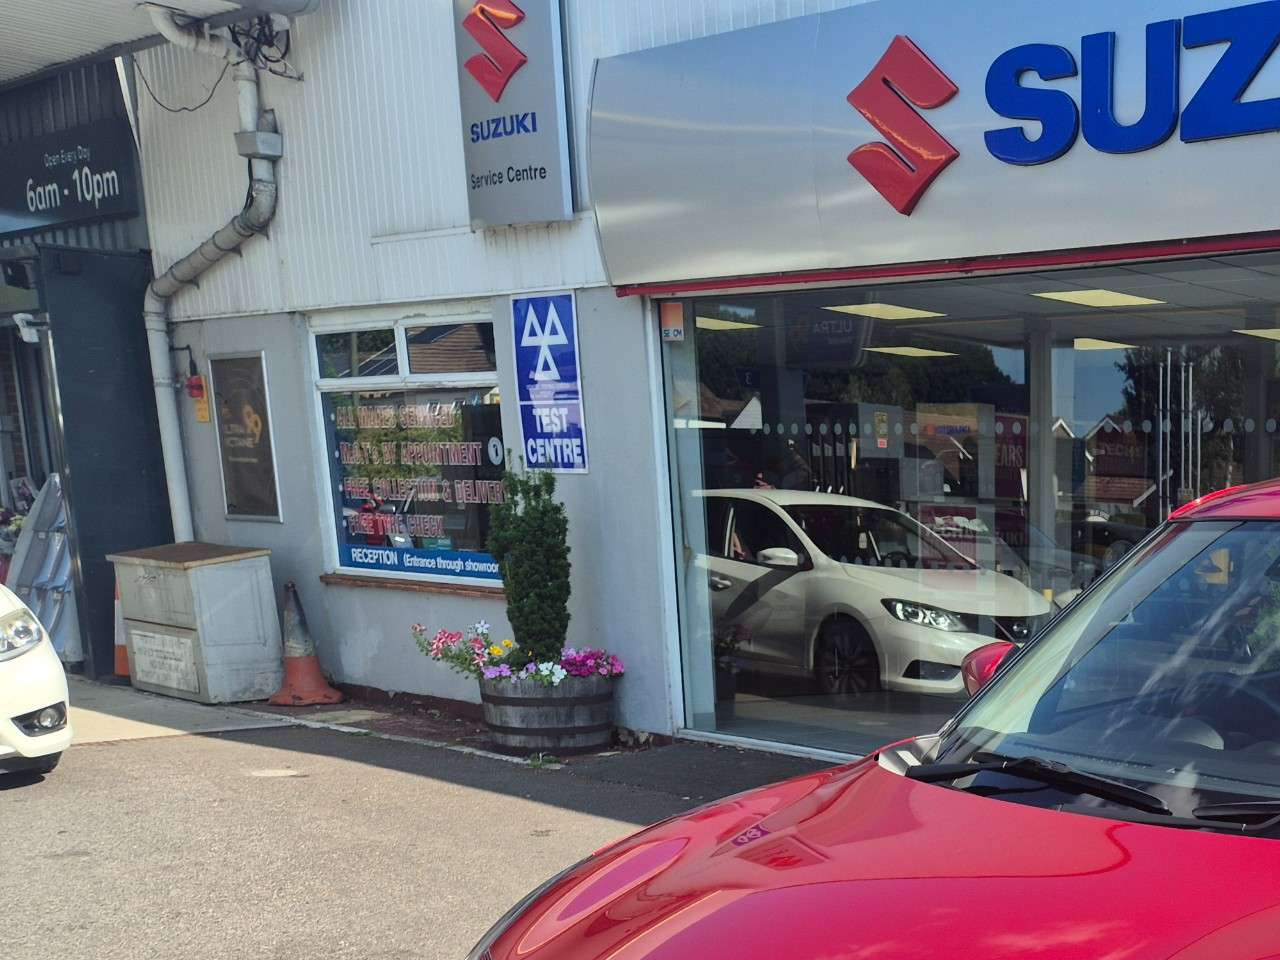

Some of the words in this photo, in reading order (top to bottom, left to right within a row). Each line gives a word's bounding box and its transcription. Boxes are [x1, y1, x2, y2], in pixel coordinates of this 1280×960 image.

[470, 112, 538, 143] SUZUKI
[26, 178, 60, 212] 6am
[72, 166, 119, 209] 10pm
[471, 170, 503, 190] Service
[507, 165, 547, 183] Centre
[336, 406, 356, 429] ALL
[533, 408, 569, 433] TEST
[382, 441, 397, 465] BY
[401, 441, 482, 466] APPOINTMENT
[527, 438, 583, 464] CENTRE
[343, 477, 371, 499] FREE
[372, 477, 439, 501] COLLECTION
[442, 479, 453, 502] &
[454, 479, 507, 504] DELIVER
[349, 513, 374, 536] FREE
[407, 514, 446, 538] CHECK
[351, 548, 398, 565] RECEPTION
[403, 551, 436, 568] (Entrance
[437, 558, 464, 573] through
